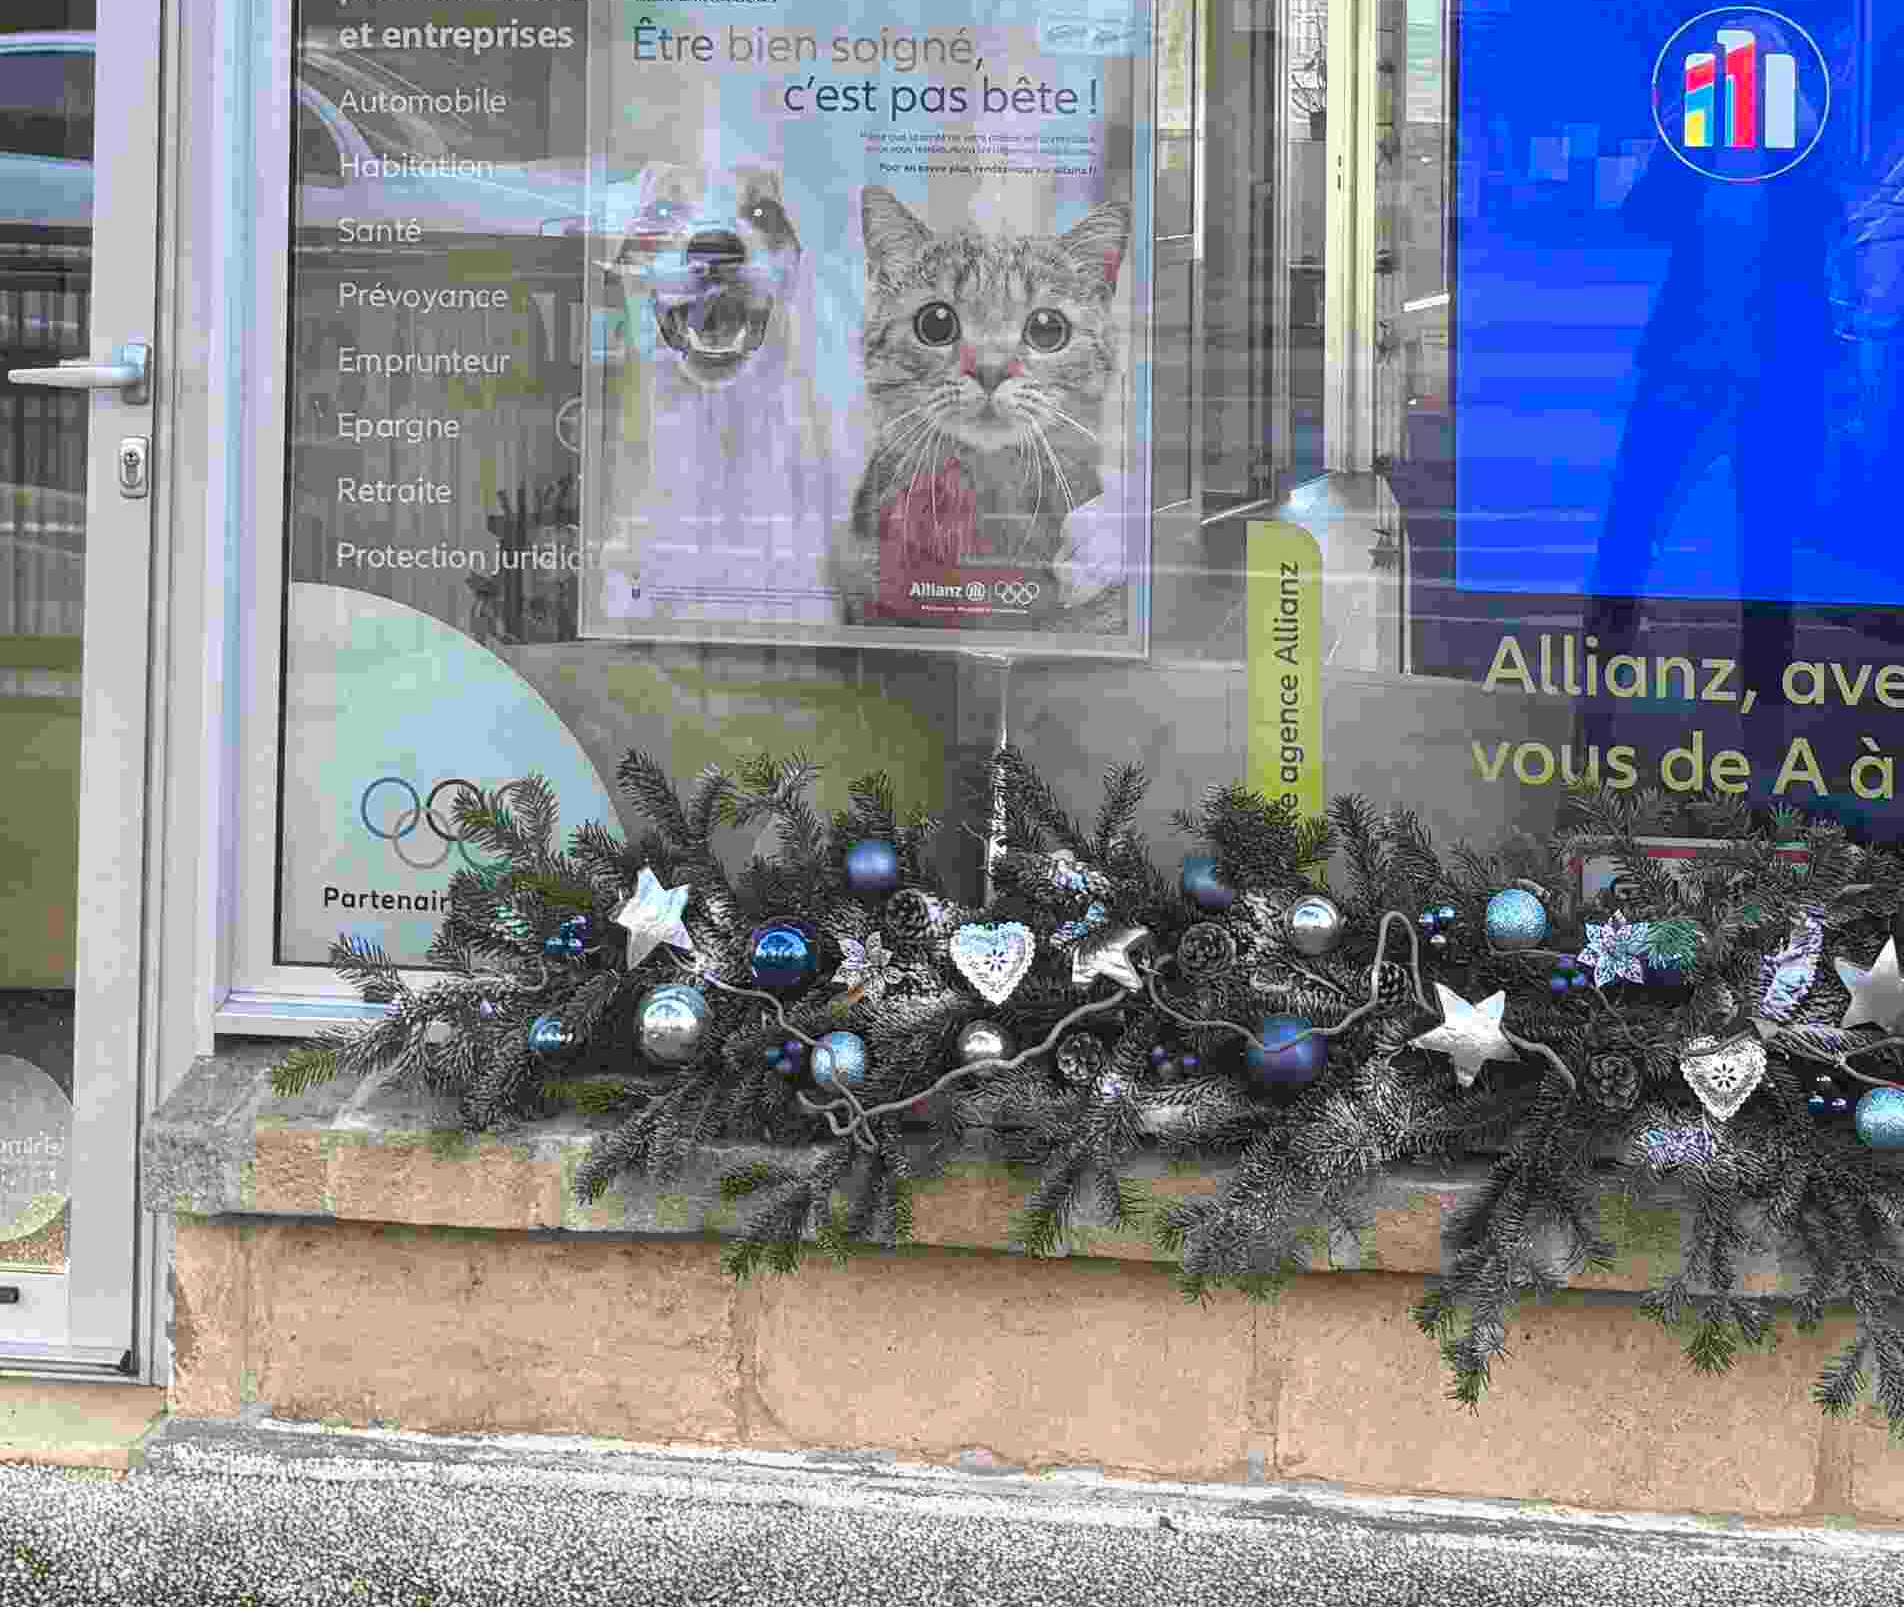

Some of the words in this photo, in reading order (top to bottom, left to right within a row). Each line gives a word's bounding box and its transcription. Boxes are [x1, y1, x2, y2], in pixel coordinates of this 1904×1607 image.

[338, 21, 375, 50] et
[381, 18, 575, 56] entreprises
[632, 15, 715, 64] Être
[727, 24, 817, 64] bien
[831, 26, 986, 74] soigné,
[337, 88, 508, 115] Automobile
[783, 80, 877, 115] c’est
[890, 87, 969, 122] pas
[338, 151, 496, 180] Habitation
[336, 215, 424, 244] Santé
[337, 280, 510, 315] Prévoyance
[338, 347, 512, 380] Emprunteur
[336, 412, 462, 445] Epargne
[336, 476, 454, 504] Retraite
[335, 541, 486, 571] Protection
[909, 581, 963, 599] Allianz
[1272, 560, 1300, 666] Allianz
[1480, 632, 1759, 715] Allianz,
[1279, 672, 1305, 784] agence
[1470, 738, 1640, 791] vous
[1659, 728, 1753, 795] de
[1771, 735, 1830, 798] A
[1849, 735, 1896, 801] à
